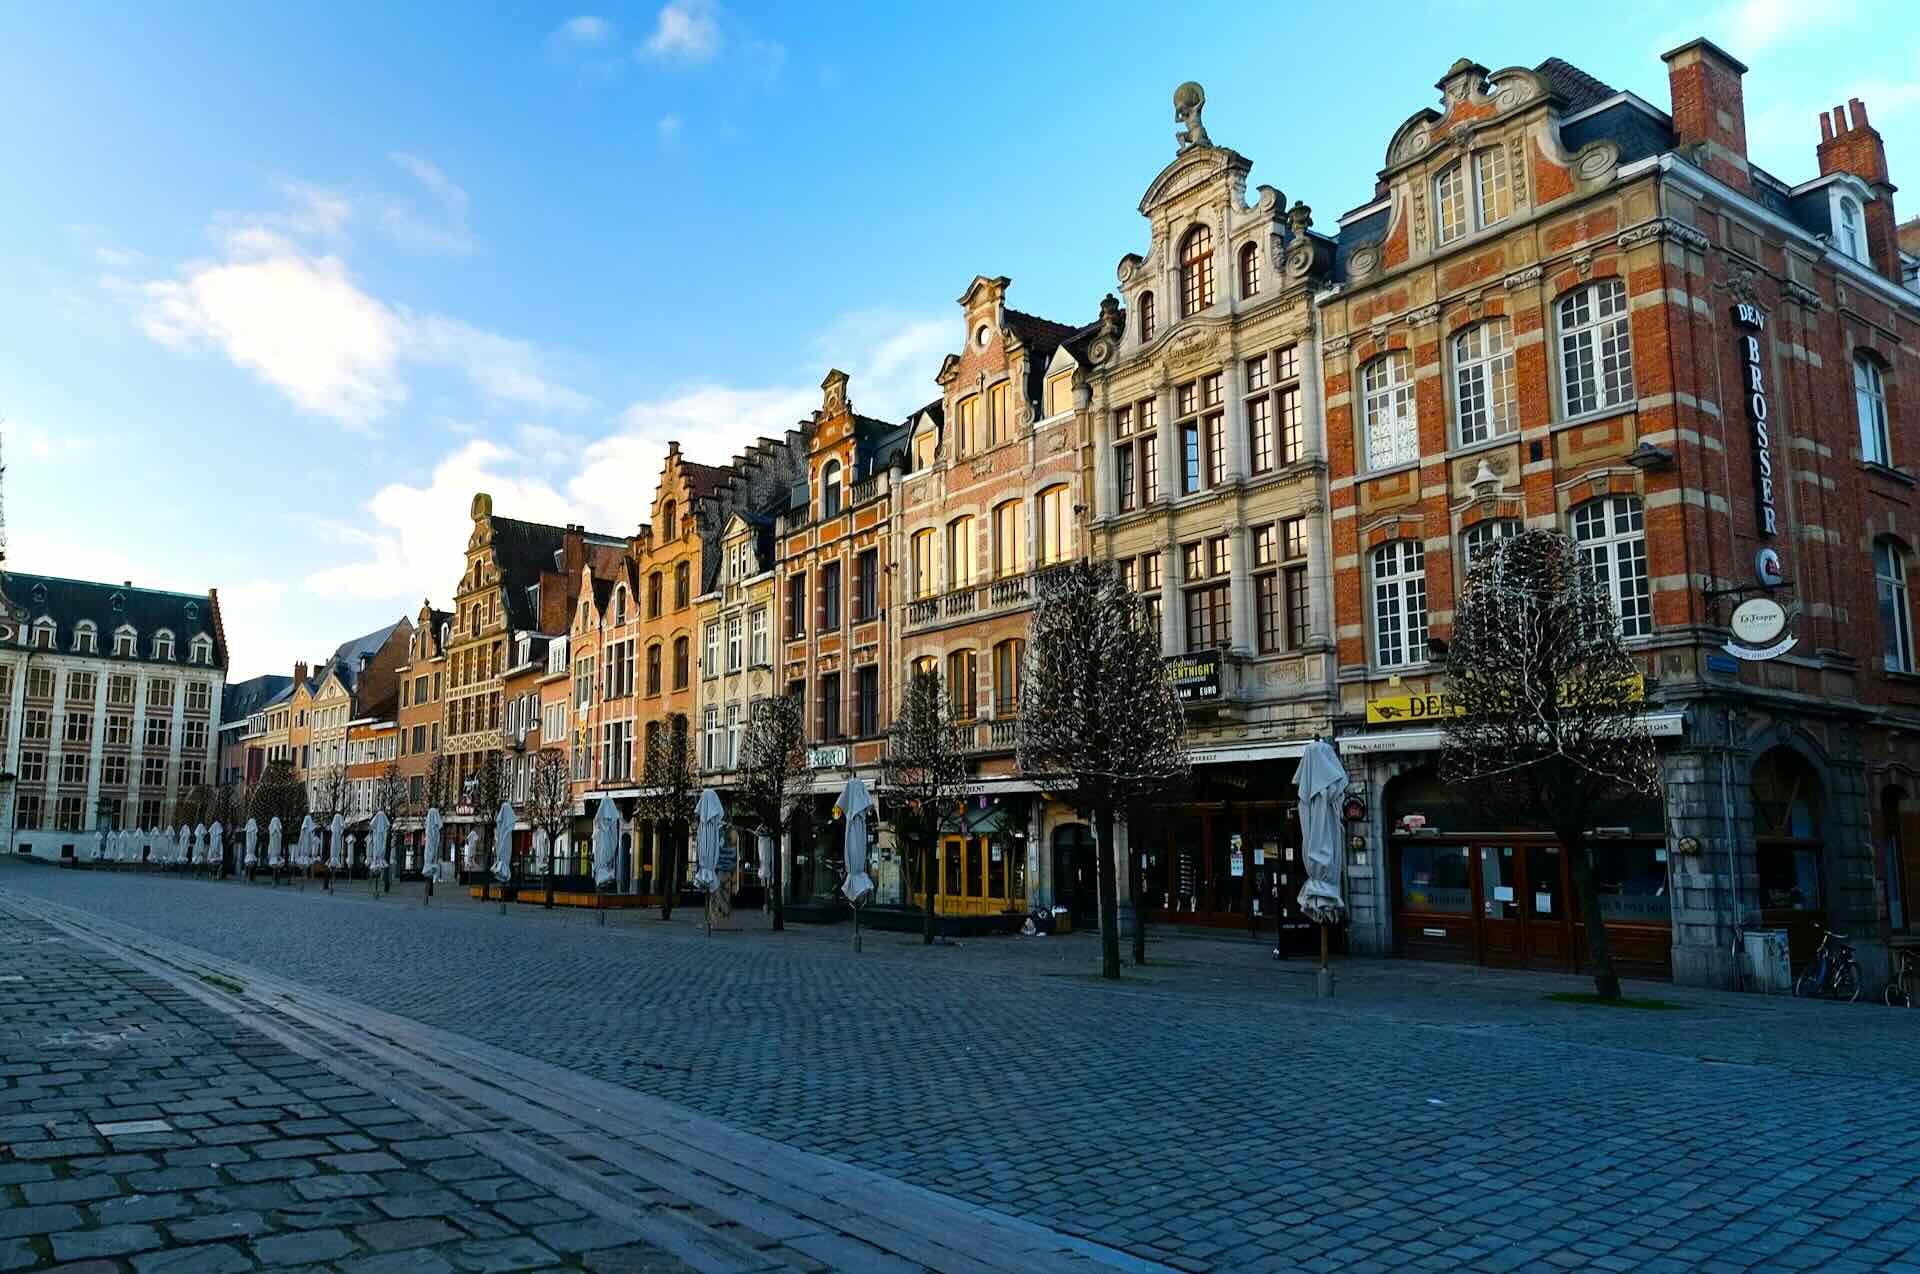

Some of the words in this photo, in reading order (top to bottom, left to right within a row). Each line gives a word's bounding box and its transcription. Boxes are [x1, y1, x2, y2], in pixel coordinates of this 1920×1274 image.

[1738, 303, 1765, 331] DEN
[1747, 335, 1777, 536] BROSSER
[1199, 685, 1217, 697] EURO
